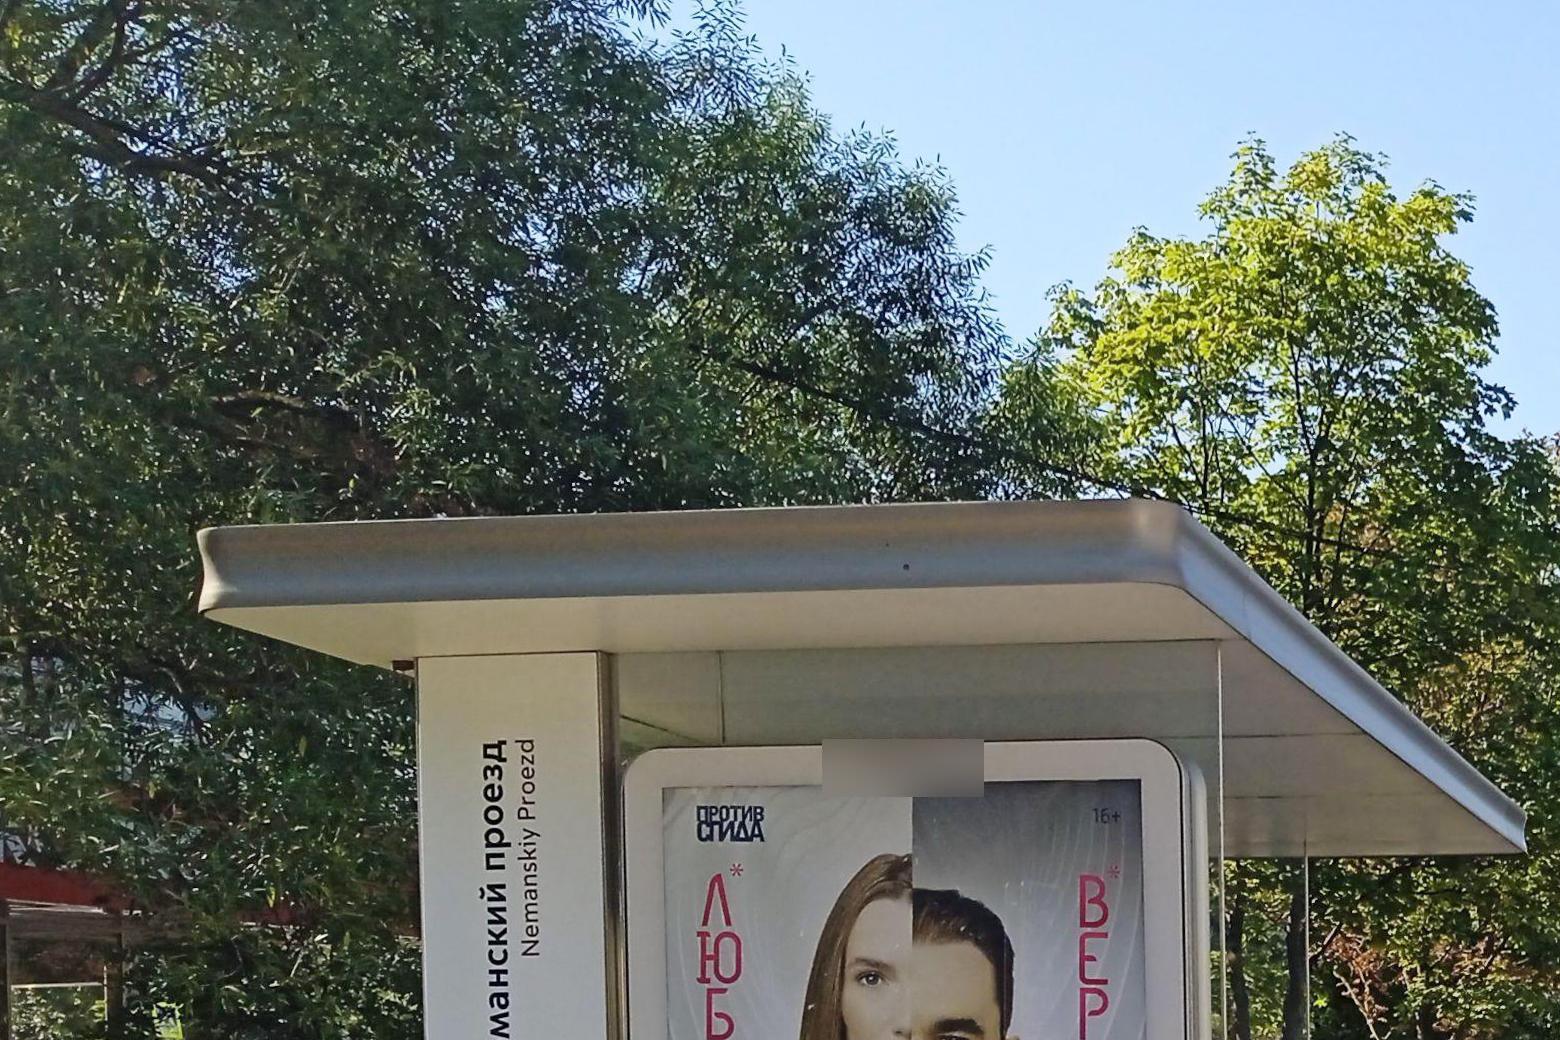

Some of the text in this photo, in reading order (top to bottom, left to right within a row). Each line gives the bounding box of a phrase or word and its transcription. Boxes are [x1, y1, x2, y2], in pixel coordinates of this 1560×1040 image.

[482, 739, 511, 871] проезд
[696, 805, 765, 822] ПРОТИВ
[1092, 807, 1121, 824] 16+
[696, 820, 765, 842] СПИДА
[515, 739, 541, 956] Nemanskiy Proezd
